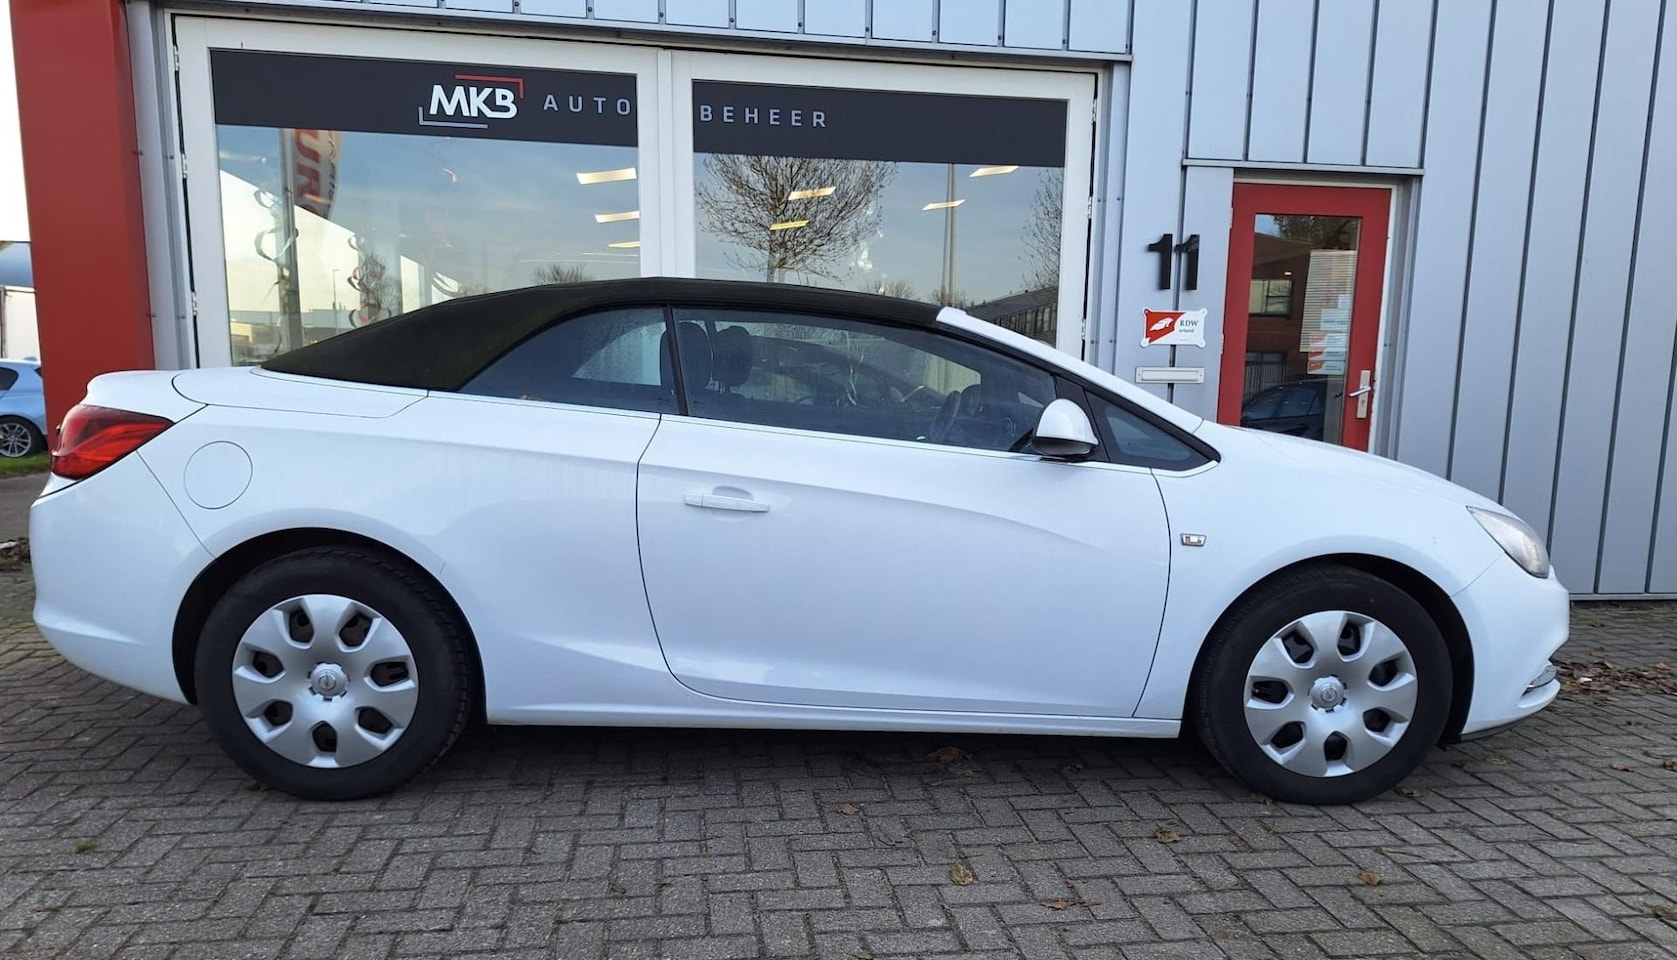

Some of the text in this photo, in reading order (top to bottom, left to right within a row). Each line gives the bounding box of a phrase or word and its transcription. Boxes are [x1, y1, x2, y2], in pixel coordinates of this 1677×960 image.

[429, 84, 827, 128] MKB AUTO BEHEER
[1147, 233, 1200, 290] 11
